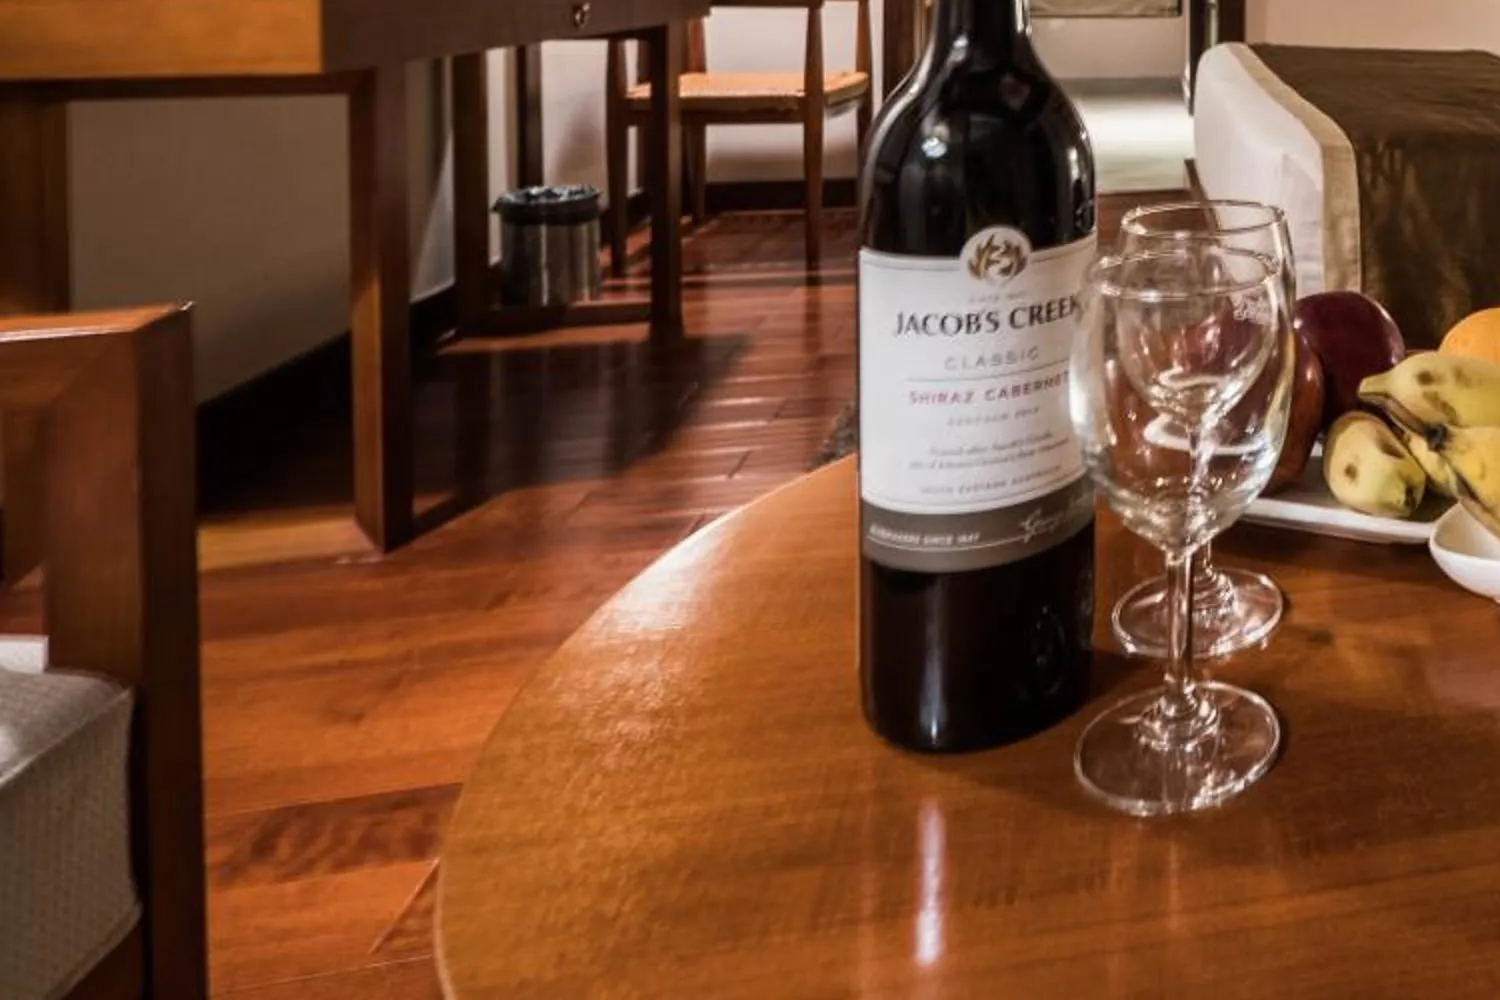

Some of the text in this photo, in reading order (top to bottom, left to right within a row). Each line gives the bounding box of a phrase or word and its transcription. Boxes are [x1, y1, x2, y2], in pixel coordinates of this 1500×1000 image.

[893, 309, 1001, 338] JACOB'S
[943, 345, 1040, 372] CLASSIC
[908, 390, 975, 406] SHIRAZ
